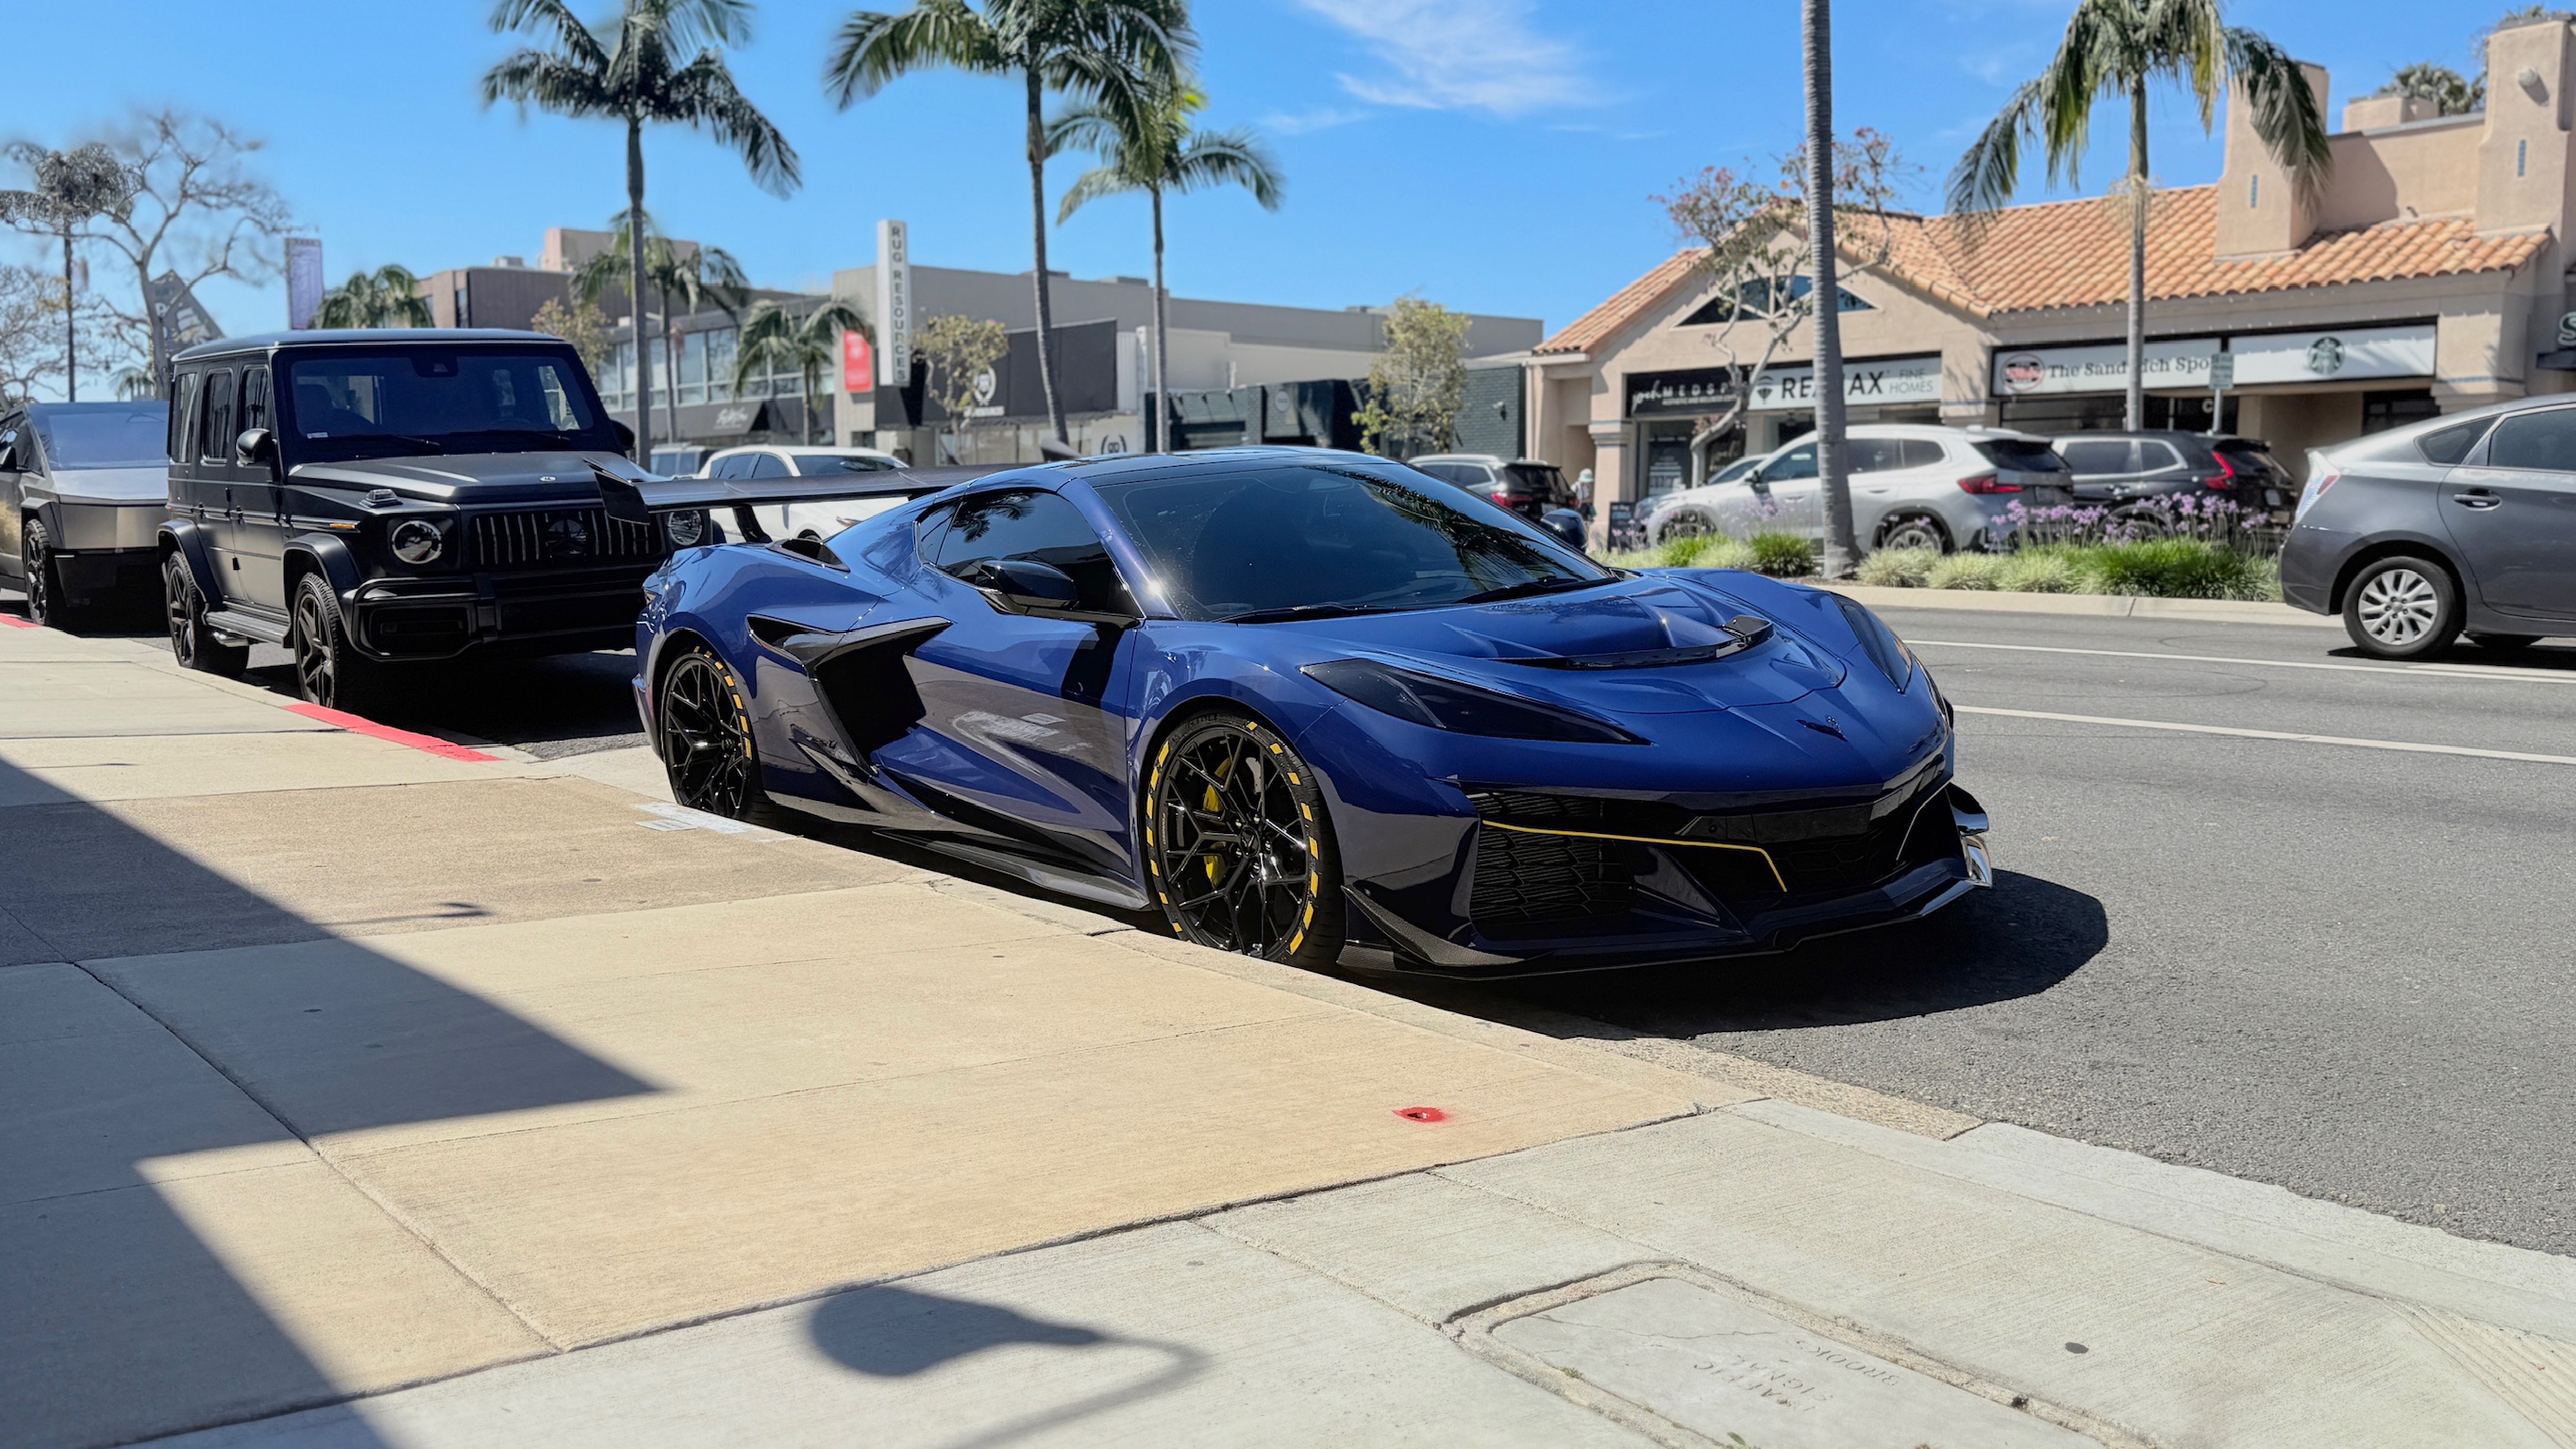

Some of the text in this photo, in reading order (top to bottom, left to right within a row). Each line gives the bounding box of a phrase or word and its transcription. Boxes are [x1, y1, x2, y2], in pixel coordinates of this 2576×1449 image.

[892, 226, 906, 380] RUG RESOURCES
[1899, 368, 1926, 380] FINE
[2049, 364, 2083, 378] The
[2083, 358, 2170, 377] Sandich
[2175, 356, 2211, 375] Spo
[1663, 382, 1731, 397] MEDSP
[1889, 380, 1932, 394] HOMES
